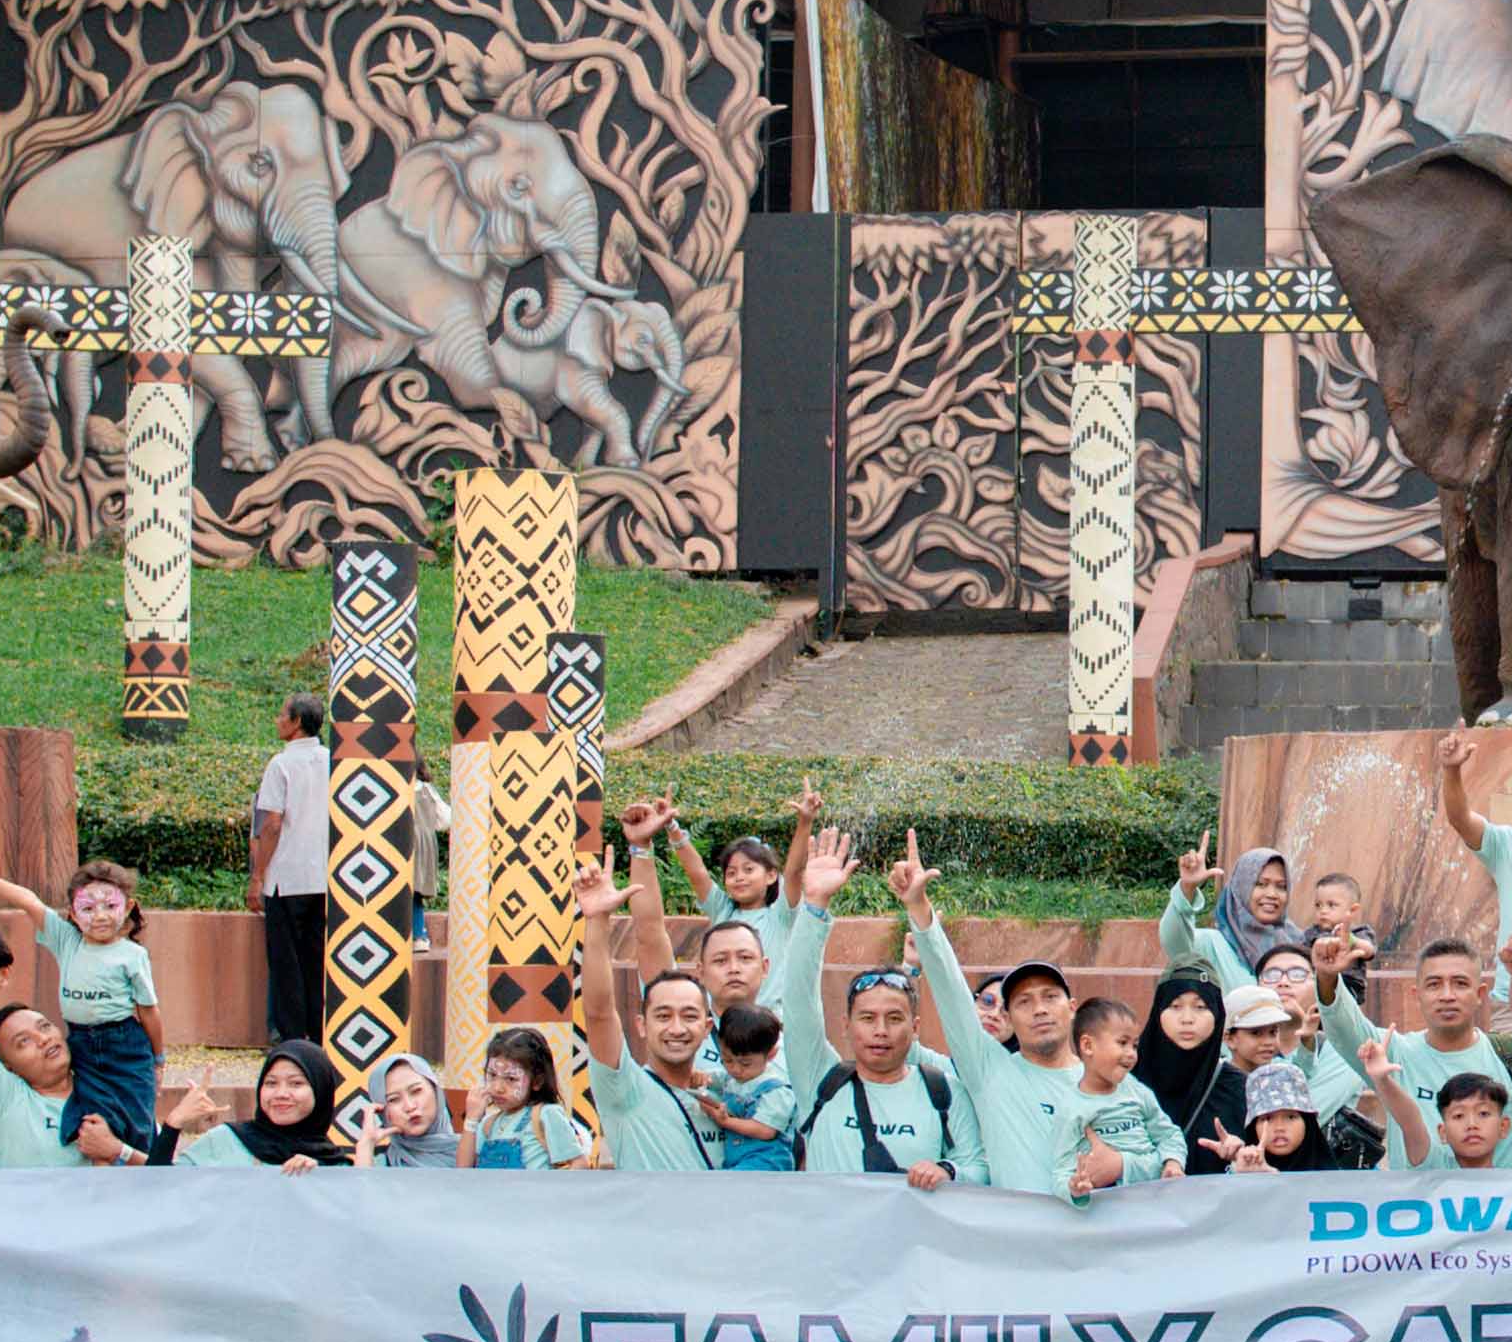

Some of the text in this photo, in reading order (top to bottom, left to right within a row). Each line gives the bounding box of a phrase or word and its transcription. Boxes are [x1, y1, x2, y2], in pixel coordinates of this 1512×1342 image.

[843, 1115, 916, 1137] DWA
[1306, 1255, 1339, 1274] PT
[1342, 1252, 1424, 1274] DOWA
[1430, 1251, 1468, 1270] Eco
